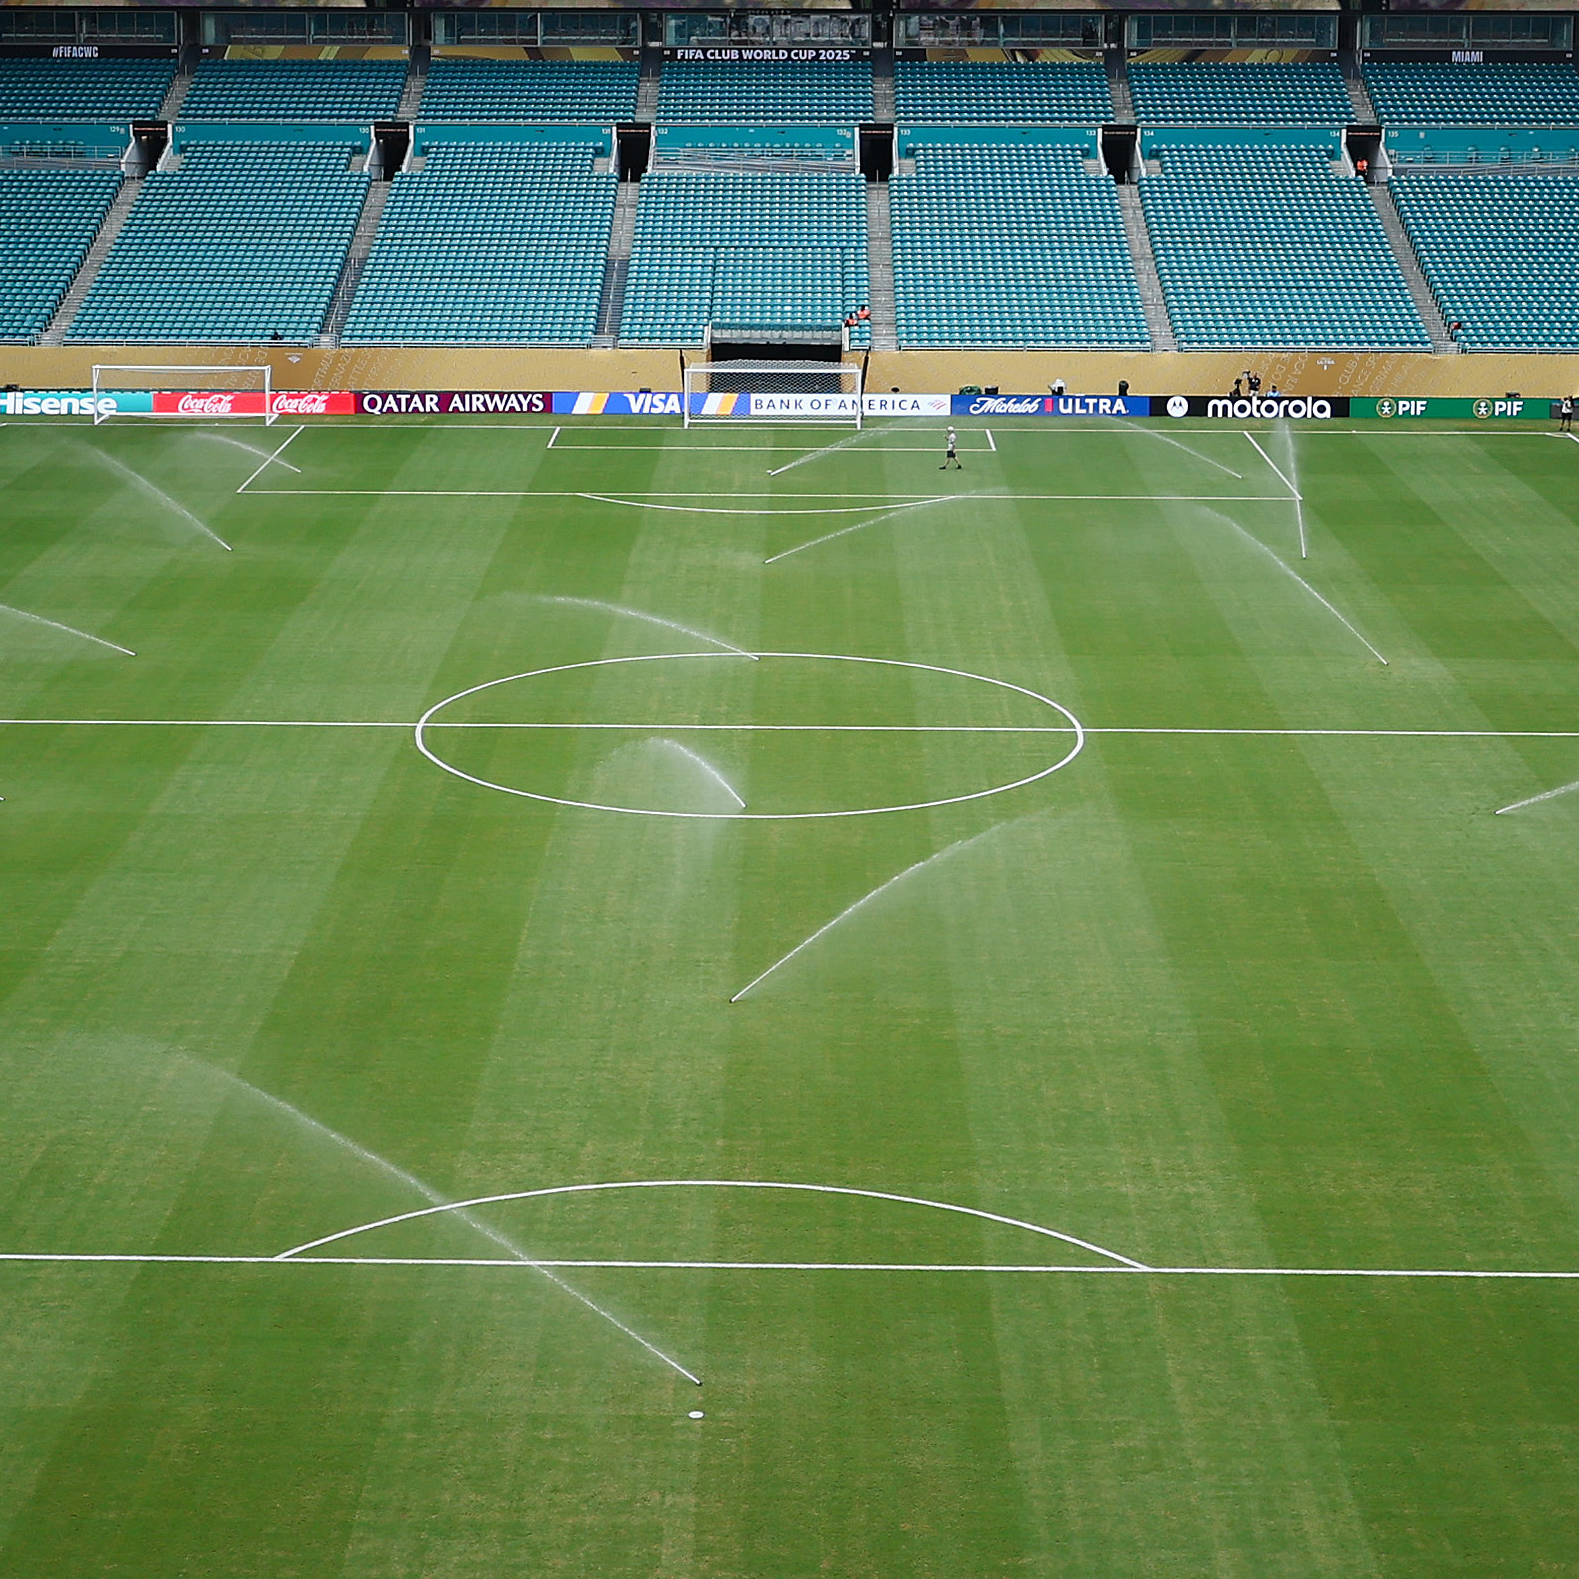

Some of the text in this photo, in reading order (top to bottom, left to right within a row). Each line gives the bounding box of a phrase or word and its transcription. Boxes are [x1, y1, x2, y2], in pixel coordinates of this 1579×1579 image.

[52, 45, 99, 59] #FIFACWC
[677, 49, 704, 61] FIFA
[706, 49, 739, 61] CLUB
[742, 49, 789, 61] WORLD
[792, 49, 817, 61] CUP
[1452, 50, 1483, 63] MIAMI
[178, 393, 233, 413] Coca-Cola
[272, 393, 328, 413] Coca-Cola
[362, 393, 544, 414] QATAR AIRWAYS
[623, 393, 681, 414] VISA
[754, 399, 921, 411] BANK OF AMERICA
[969, 396, 1127, 414] Michelob ULTRA
[1207, 396, 1331, 418] motorola
[1397, 400, 1426, 415] PIF
[1494, 400, 1523, 416] PIF
